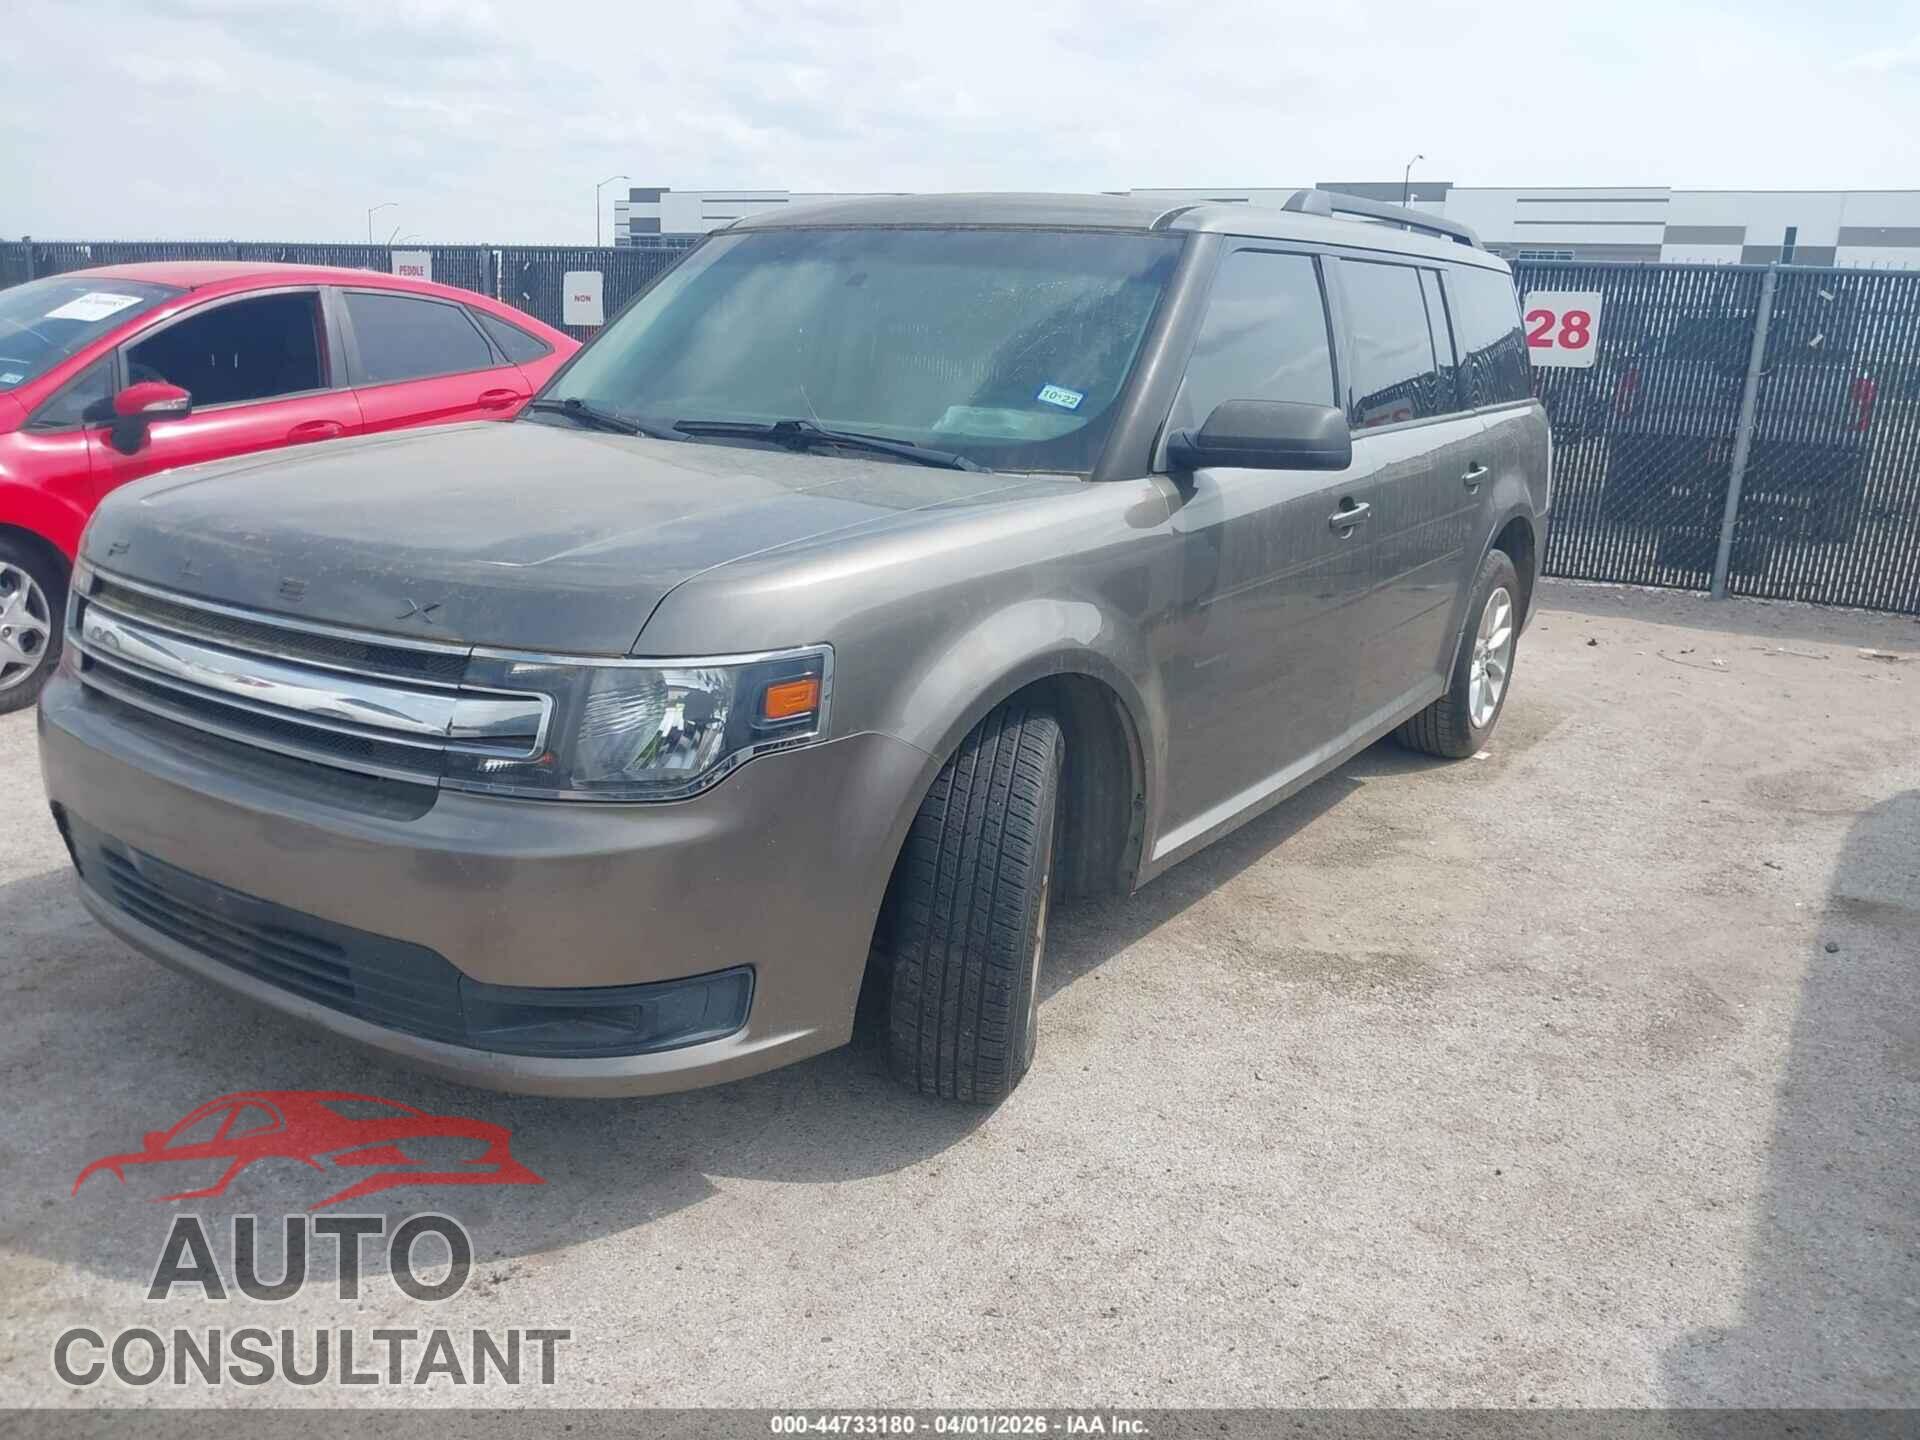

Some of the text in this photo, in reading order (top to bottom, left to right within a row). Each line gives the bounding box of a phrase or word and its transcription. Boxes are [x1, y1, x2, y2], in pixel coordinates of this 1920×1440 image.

[399, 264, 425, 277] PEDDLE
[574, 294, 592, 302] NON
[1525, 309, 1591, 349] 28
